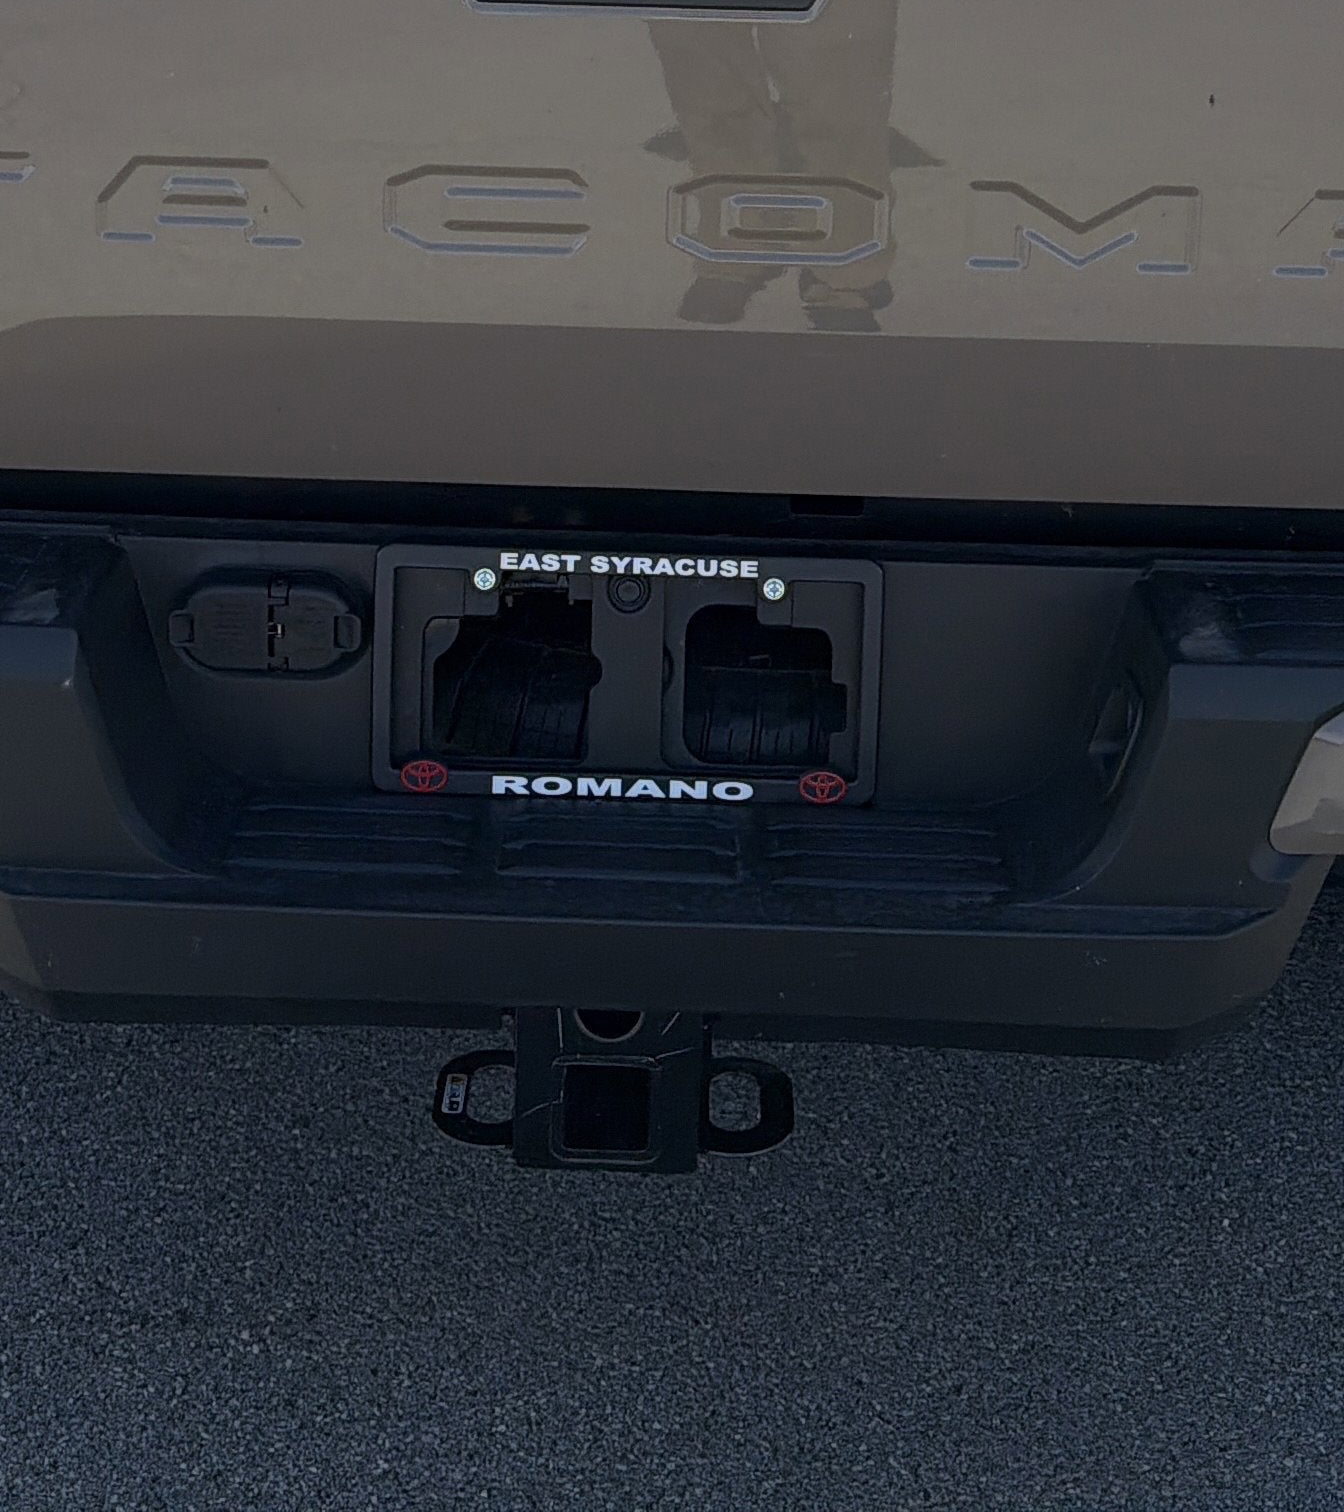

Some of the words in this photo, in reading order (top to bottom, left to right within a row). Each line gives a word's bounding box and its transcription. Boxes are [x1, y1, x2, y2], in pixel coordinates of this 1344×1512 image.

[499, 552, 582, 573] EAST
[590, 555, 760, 579] SYRACUSE
[491, 775, 754, 801] ROMANO
